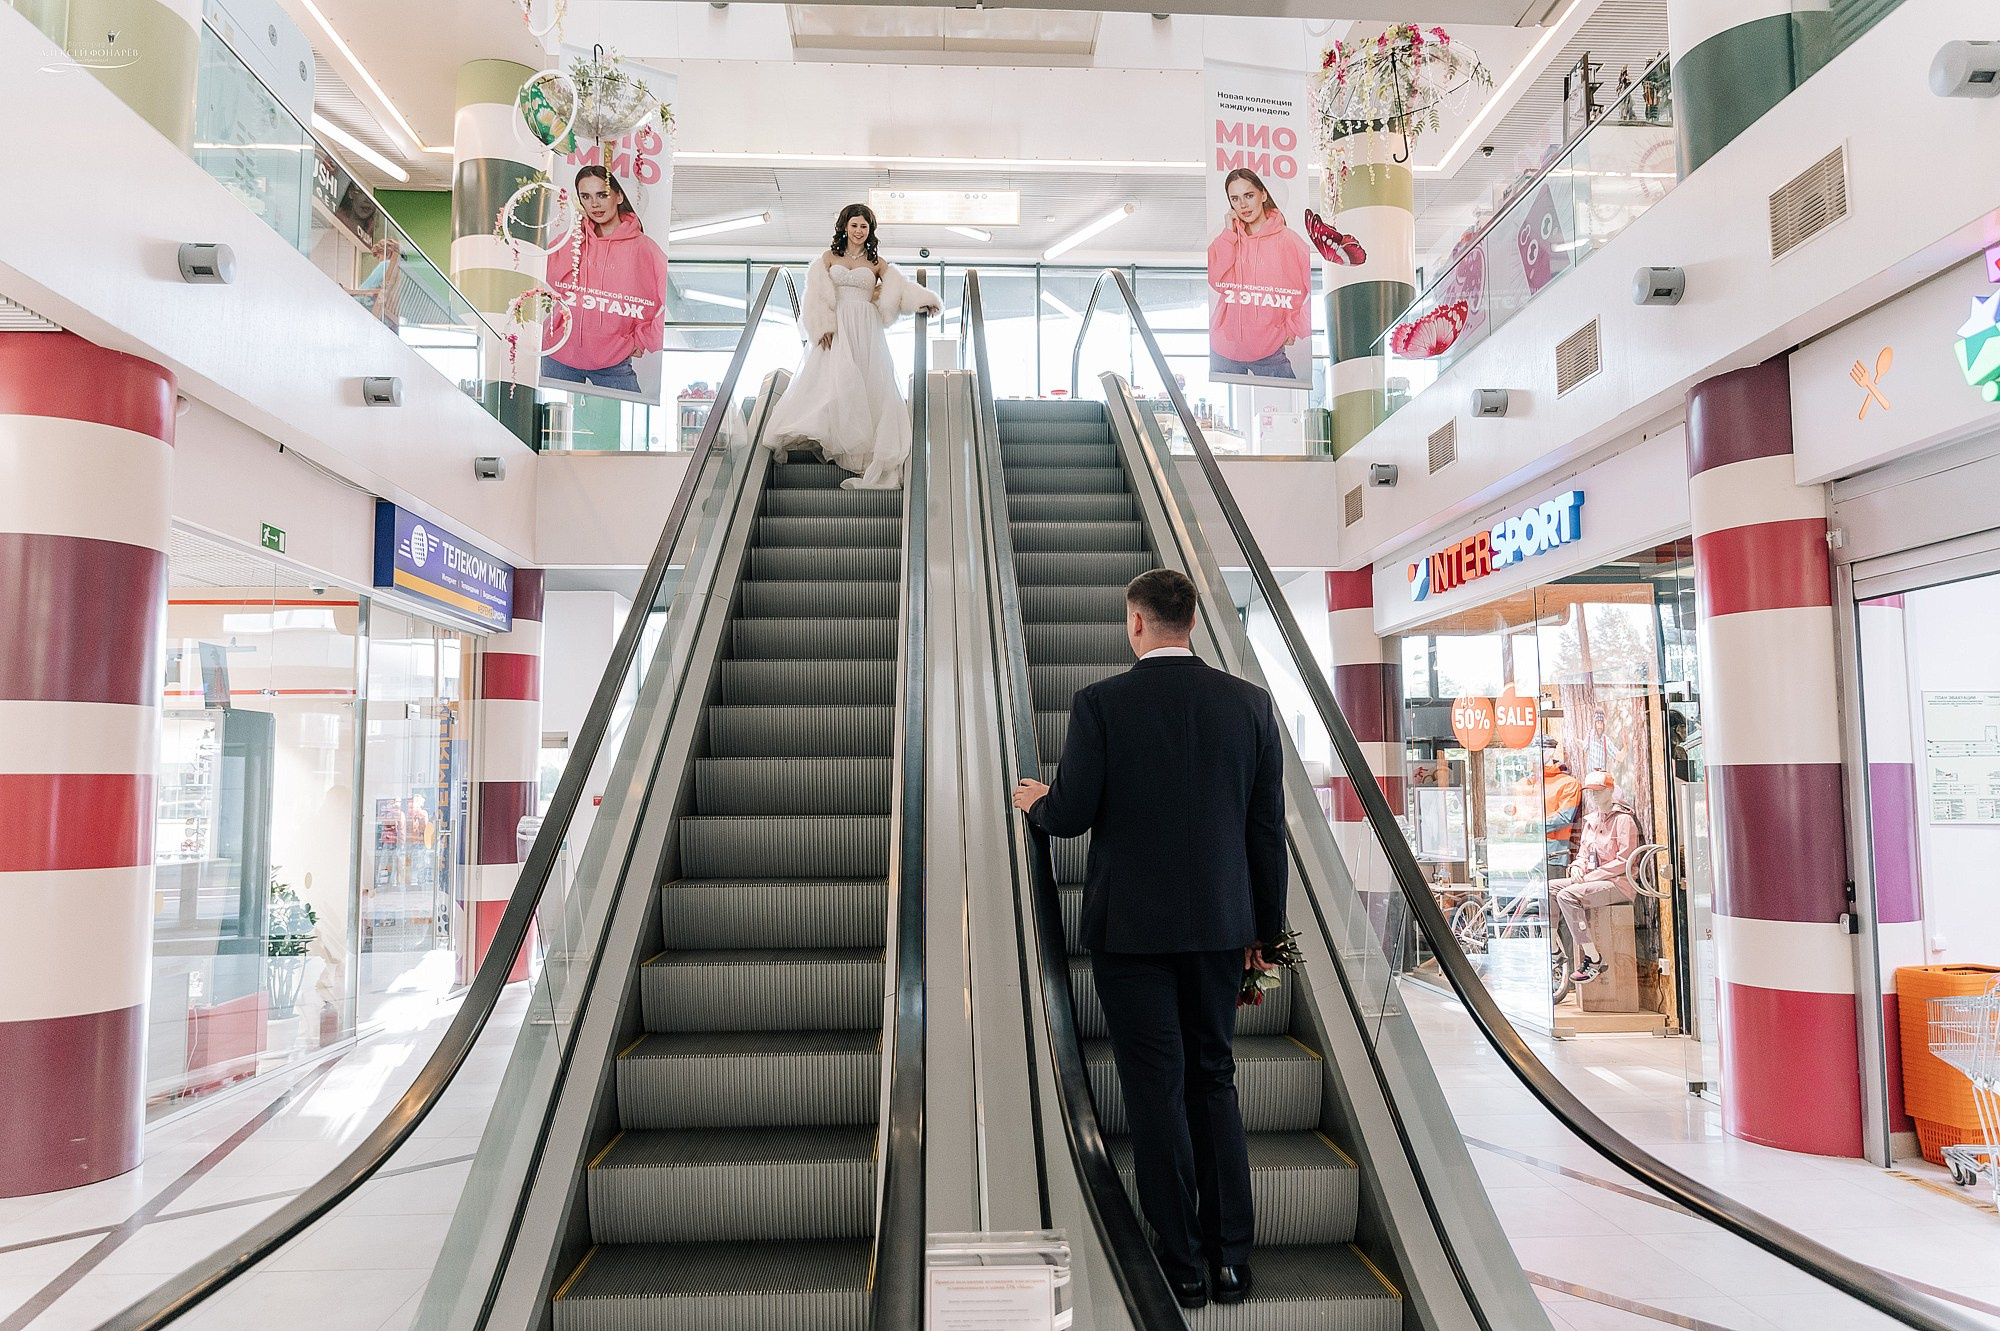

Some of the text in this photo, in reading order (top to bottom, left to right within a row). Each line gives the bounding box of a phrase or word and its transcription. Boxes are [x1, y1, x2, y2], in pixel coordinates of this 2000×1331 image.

[1217, 91, 1293, 107] Новая коллекция
[1219, 102, 1290, 116] каждую неделю
[1216, 119, 1297, 152] МИО
[1216, 147, 1298, 179] МИО
[587, 287, 623, 300] ЖЕНСКОЙ
[624, 295, 655, 307] ОДЕЖДЫ
[1223, 290, 1294, 310] 2 ЭТАЖ
[1243, 284, 1274, 293] ЖЕНСКОЙ
[1274, 287, 1302, 296] ОДЕЖДЫ
[564, 291, 645, 320] 2 ЭТАЖ
[1429, 490, 1585, 595] INTERSPORT
[442, 541, 508, 593] ТЕЛЕКОМ МПК
[1454, 708, 1491, 730] 50%
[1496, 705, 1534, 726] SALE
